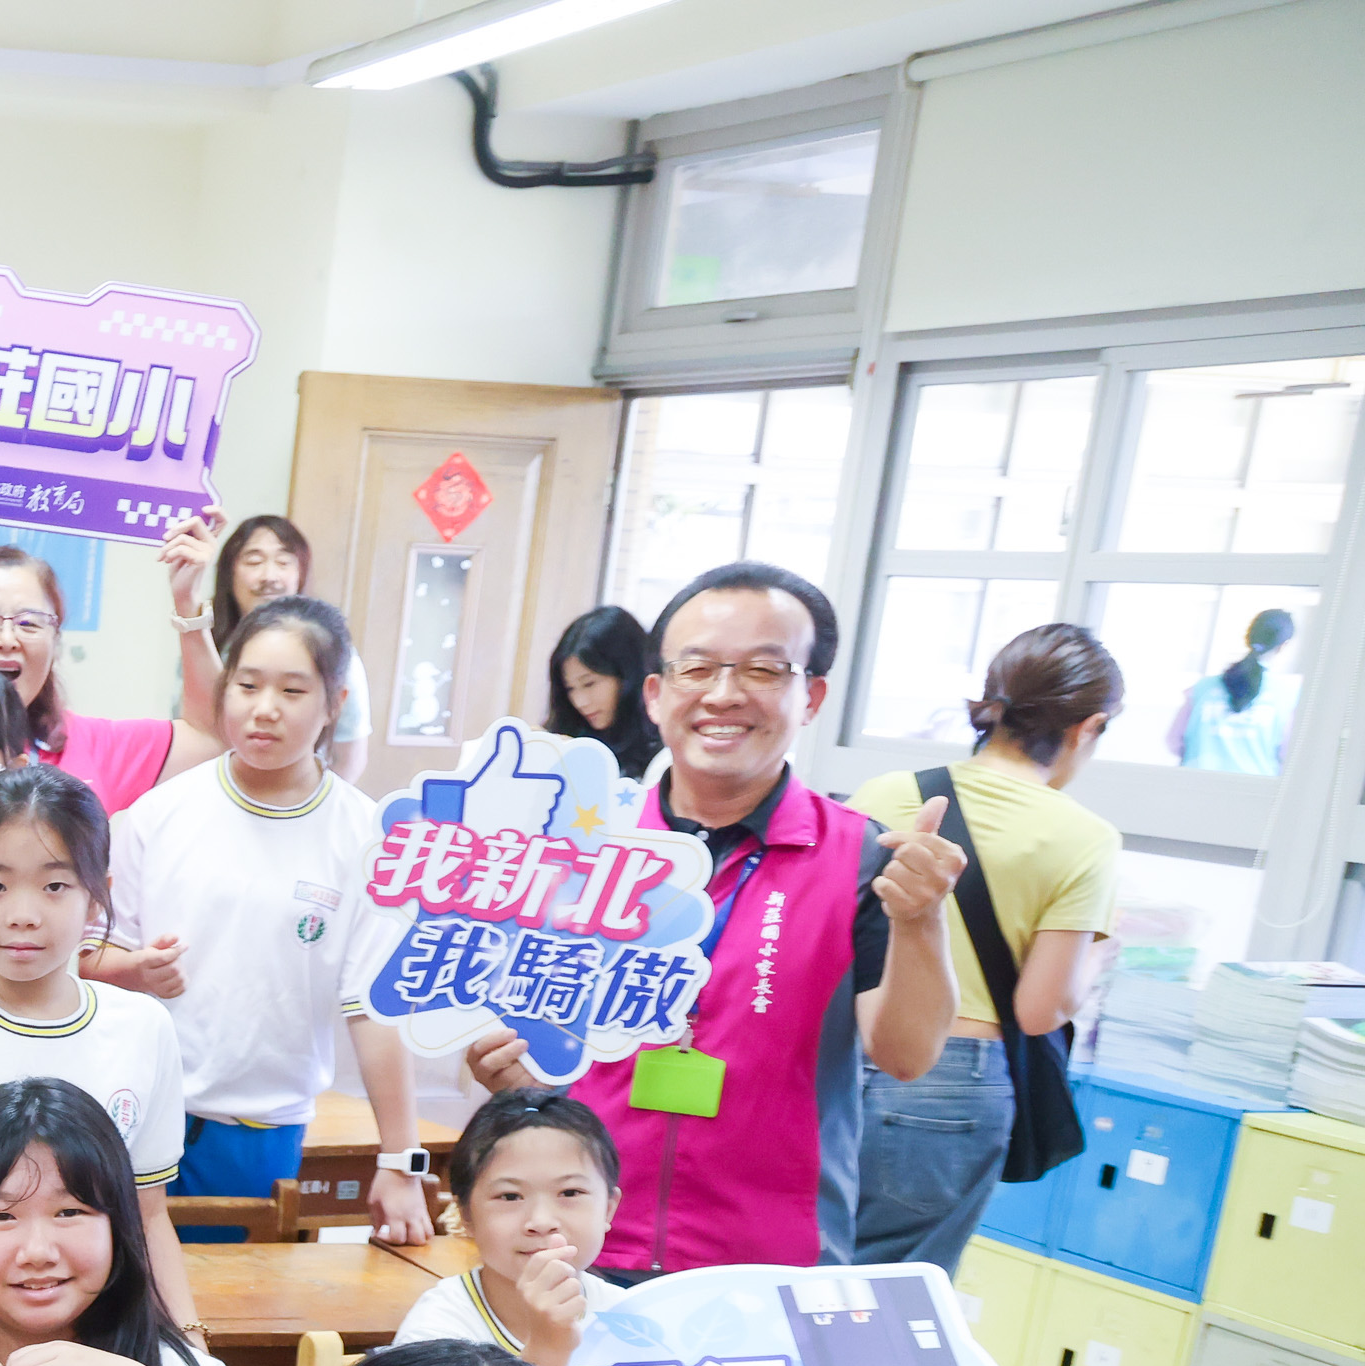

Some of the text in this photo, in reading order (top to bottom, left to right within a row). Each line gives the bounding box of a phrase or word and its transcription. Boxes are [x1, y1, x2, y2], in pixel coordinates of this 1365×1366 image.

[25, 480, 85, 516] 教育局
[372, 821, 669, 936] 我新北
[397, 922, 700, 1036] 我驕傲
[750, 890, 787, 1014] 新莊國小家長會
